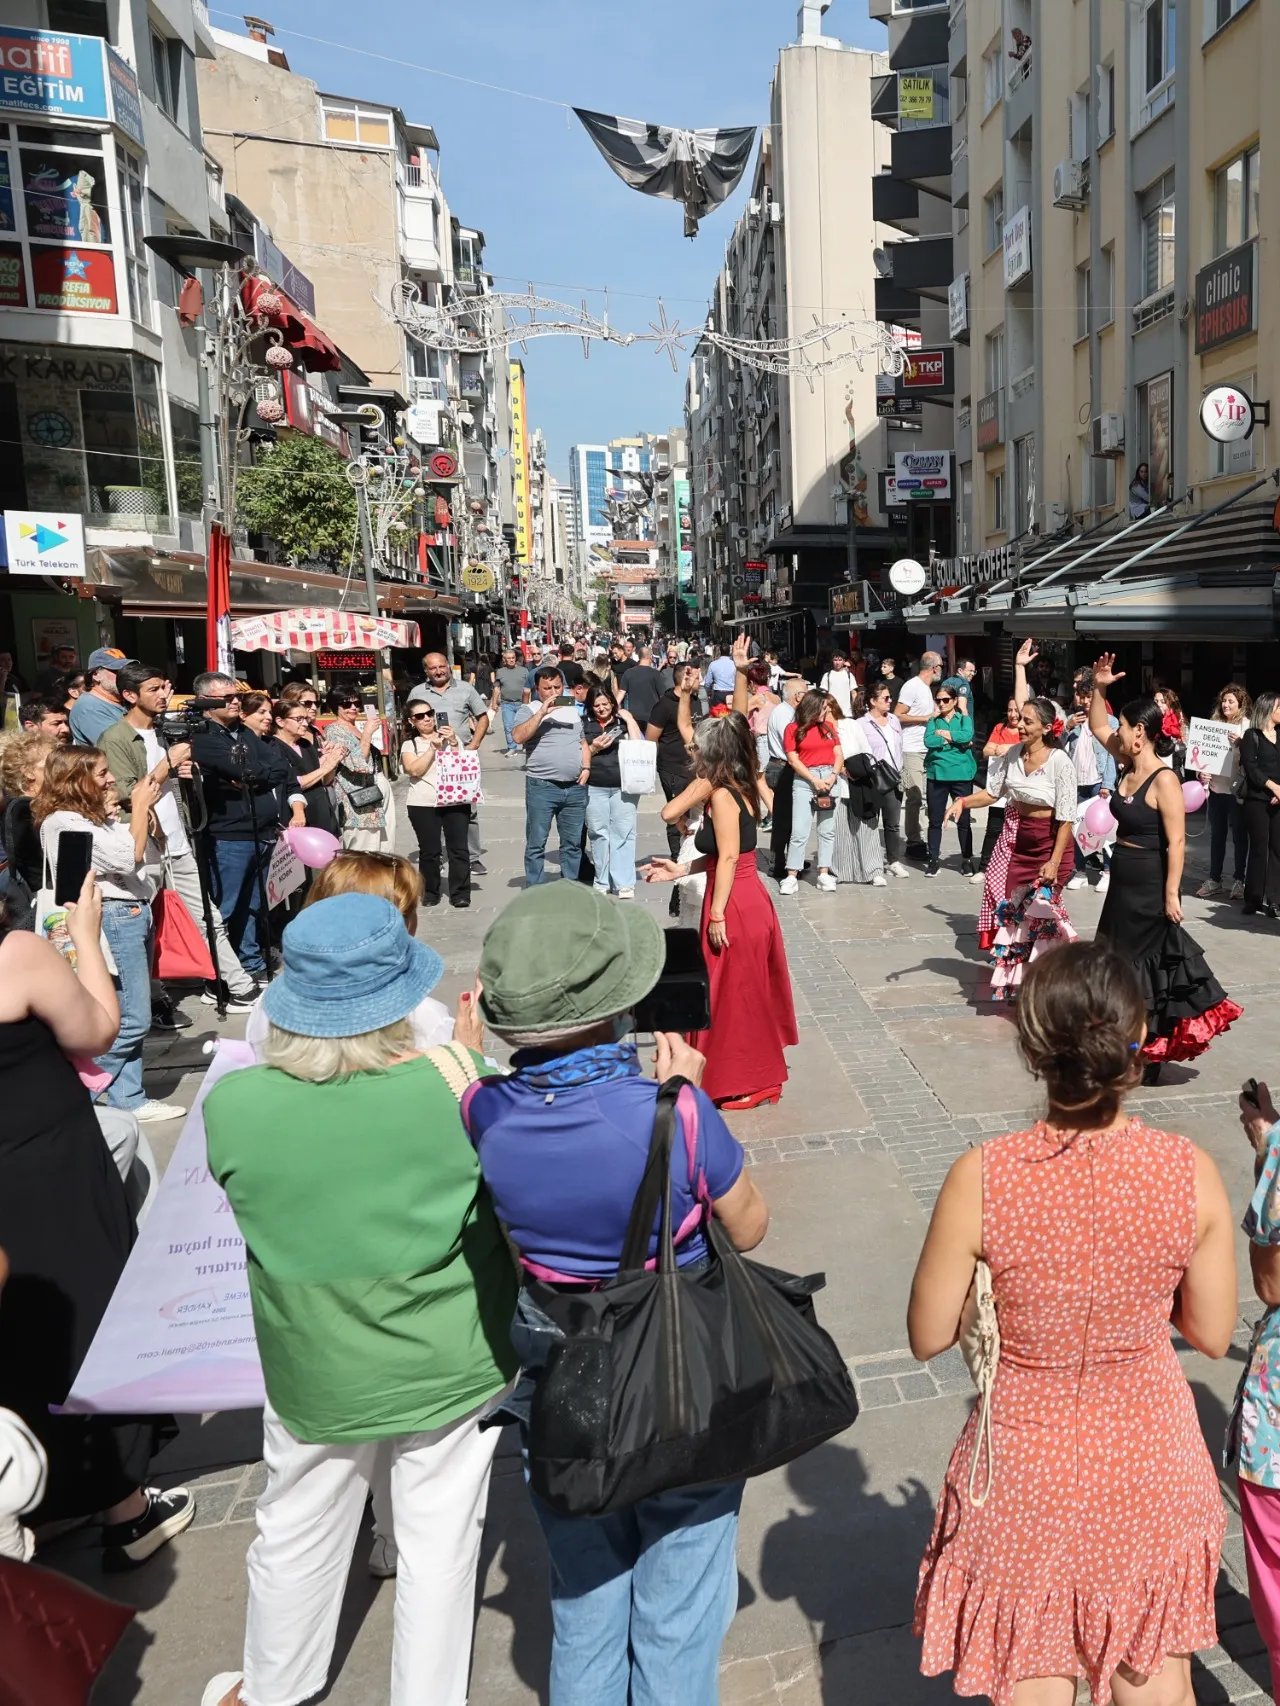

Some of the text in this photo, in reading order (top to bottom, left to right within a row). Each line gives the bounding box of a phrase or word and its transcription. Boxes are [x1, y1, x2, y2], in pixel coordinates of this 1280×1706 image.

[3, 74, 84, 103] EĞİTİM
[902, 79, 930, 90] SATILIK
[1206, 263, 1241, 306] clinic
[1199, 294, 1248, 344] EPHESUS
[918, 361, 942, 373] TKP
[512, 397, 522, 478] DALTON
[517, 496, 525, 549] KURS
[16, 559, 79, 569] Türk Telekom
[977, 543, 1012, 581] COFFEE
[279, 868, 292, 882] KORK
